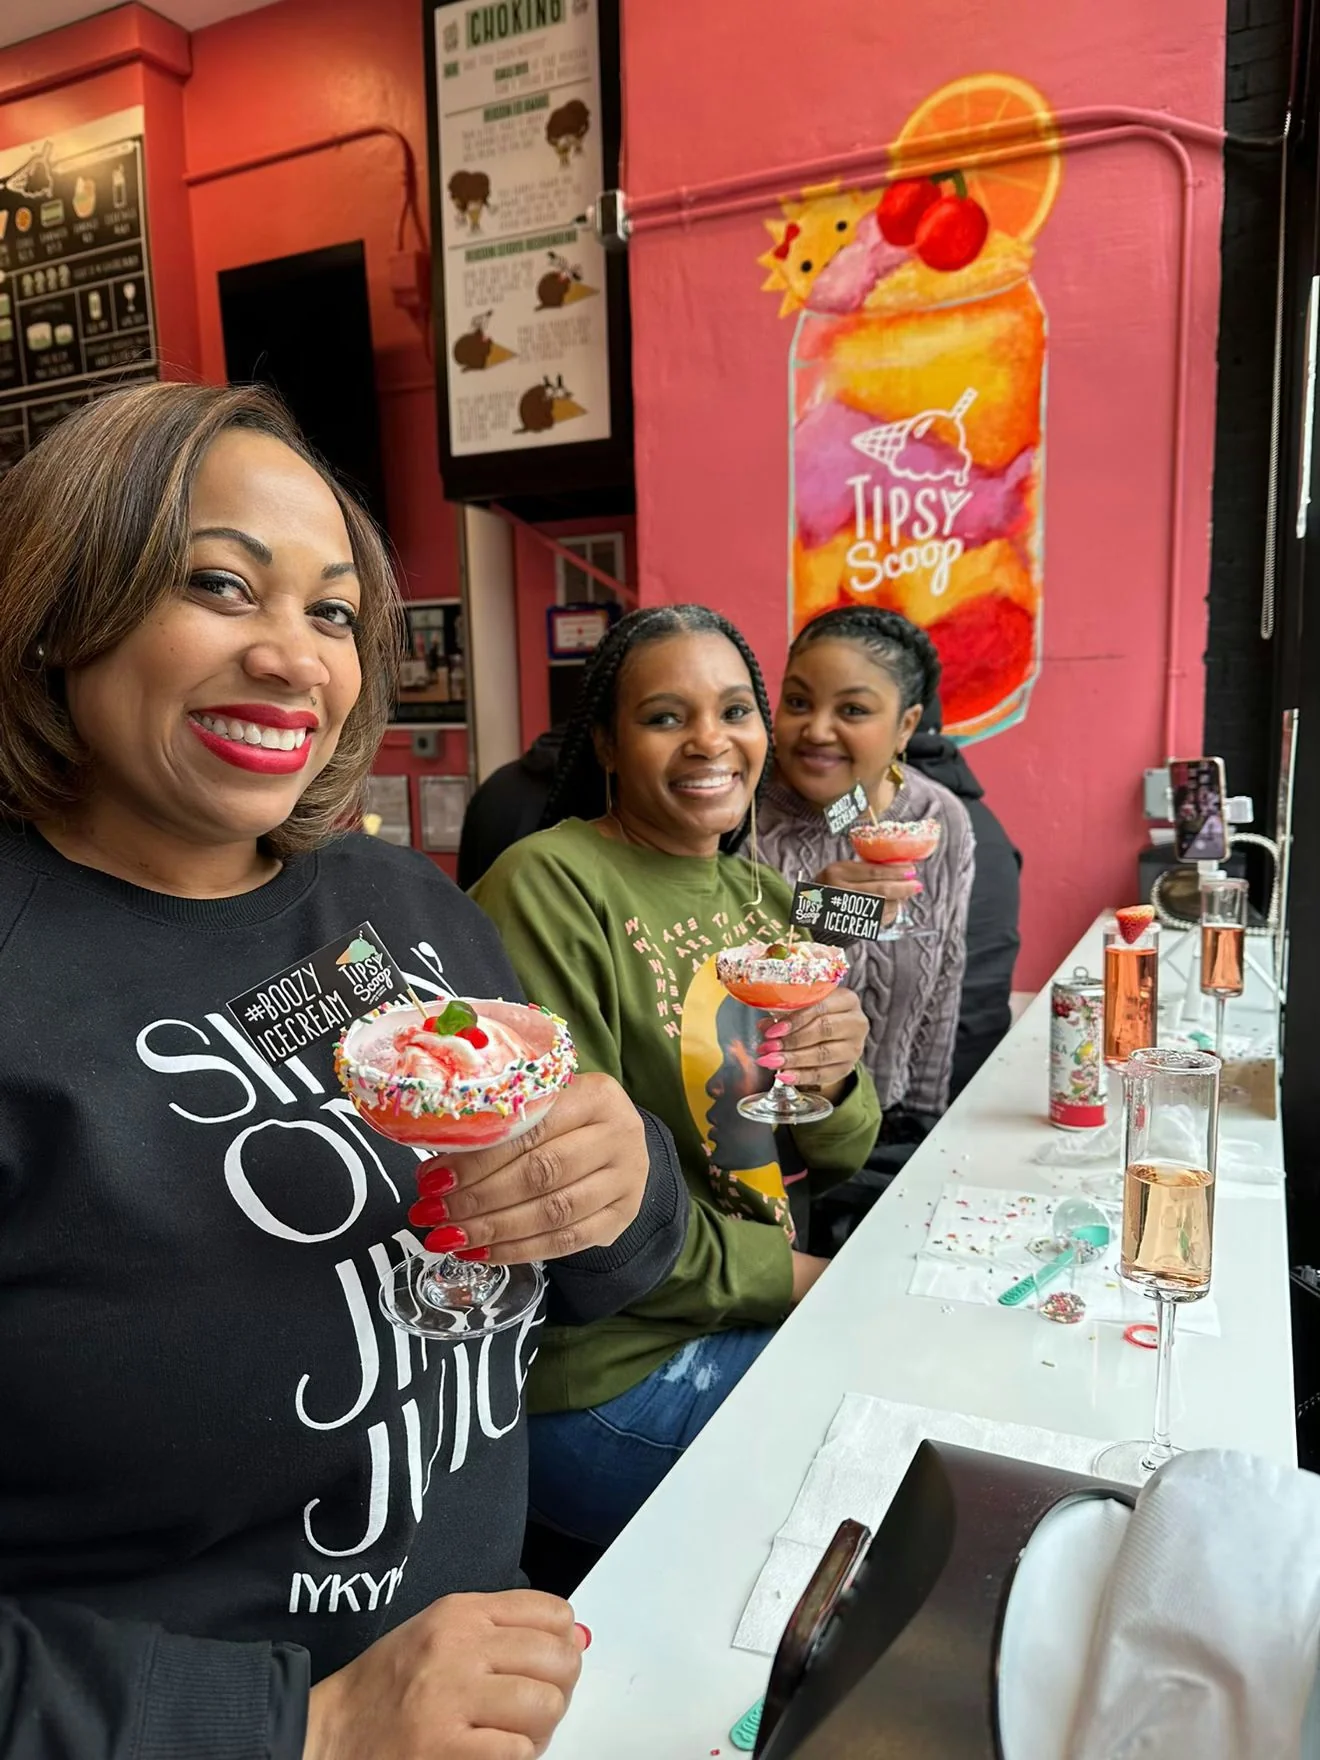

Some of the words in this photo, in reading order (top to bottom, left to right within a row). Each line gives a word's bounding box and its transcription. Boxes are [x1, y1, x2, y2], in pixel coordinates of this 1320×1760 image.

[470, 0, 560, 45] CHOKING
[845, 474, 973, 546] TIPSY
[846, 538, 963, 596] Scoop
[798, 896, 823, 912] TIPSY
[830, 894, 880, 917] #BOOZY
[824, 911, 878, 939] ICECREAM
[338, 953, 384, 986] TIPSY
[353, 967, 393, 1002] Scoop
[244, 962, 322, 1022] #BOOZY
[257, 990, 353, 1062] ICECREAM
